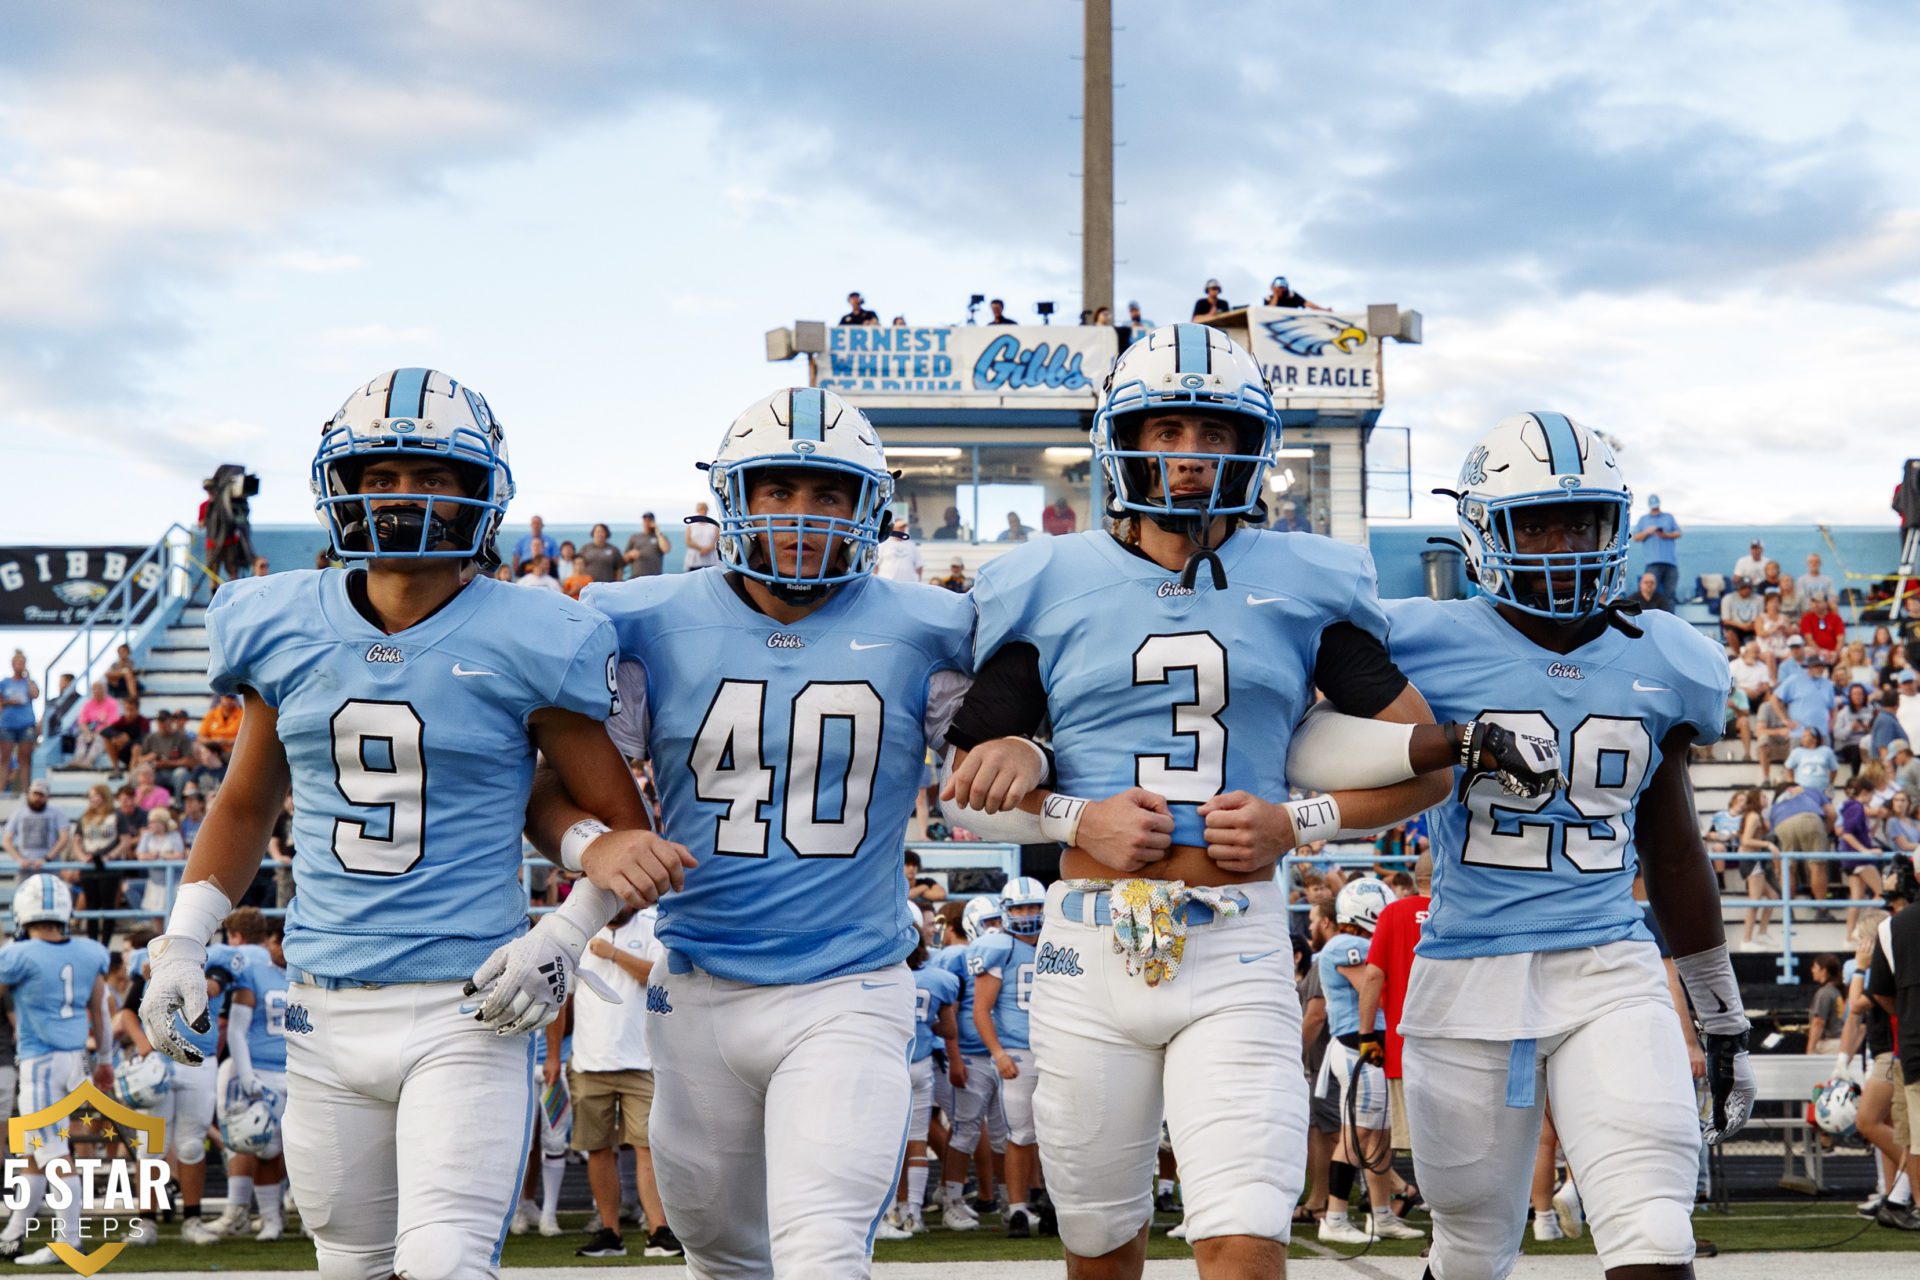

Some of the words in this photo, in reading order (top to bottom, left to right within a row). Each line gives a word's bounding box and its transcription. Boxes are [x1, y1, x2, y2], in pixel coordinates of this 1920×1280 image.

[830, 328, 952, 351] ERNEST
[830, 353, 953, 377] WHITED
[972, 333, 1093, 391] Gibbs
[1180, 374, 1205, 390] G
[1307, 366, 1372, 387] EAGLE
[390, 418, 416, 434] G
[791, 440, 816, 455] G
[1558, 475, 1582, 489] G
[0, 550, 163, 592] GIBBS
[786, 583, 812, 592] Riddell
[1157, 580, 1196, 598] Gibbs
[766, 631, 806, 649] Gibbs
[365, 643, 405, 663] Gibbs
[1546, 661, 1585, 680] Gibbs
[1132, 630, 1230, 806] 3
[686, 677, 885, 859] 40
[330, 698, 427, 876] 9
[1460, 709, 1653, 874] 29
[1036, 942, 1084, 977] Gibbs
[59, 963, 75, 1020] 1
[554, 955, 566, 1004] adidas
[645, 985, 674, 1015] bbs
[285, 1004, 314, 1035] bbs
